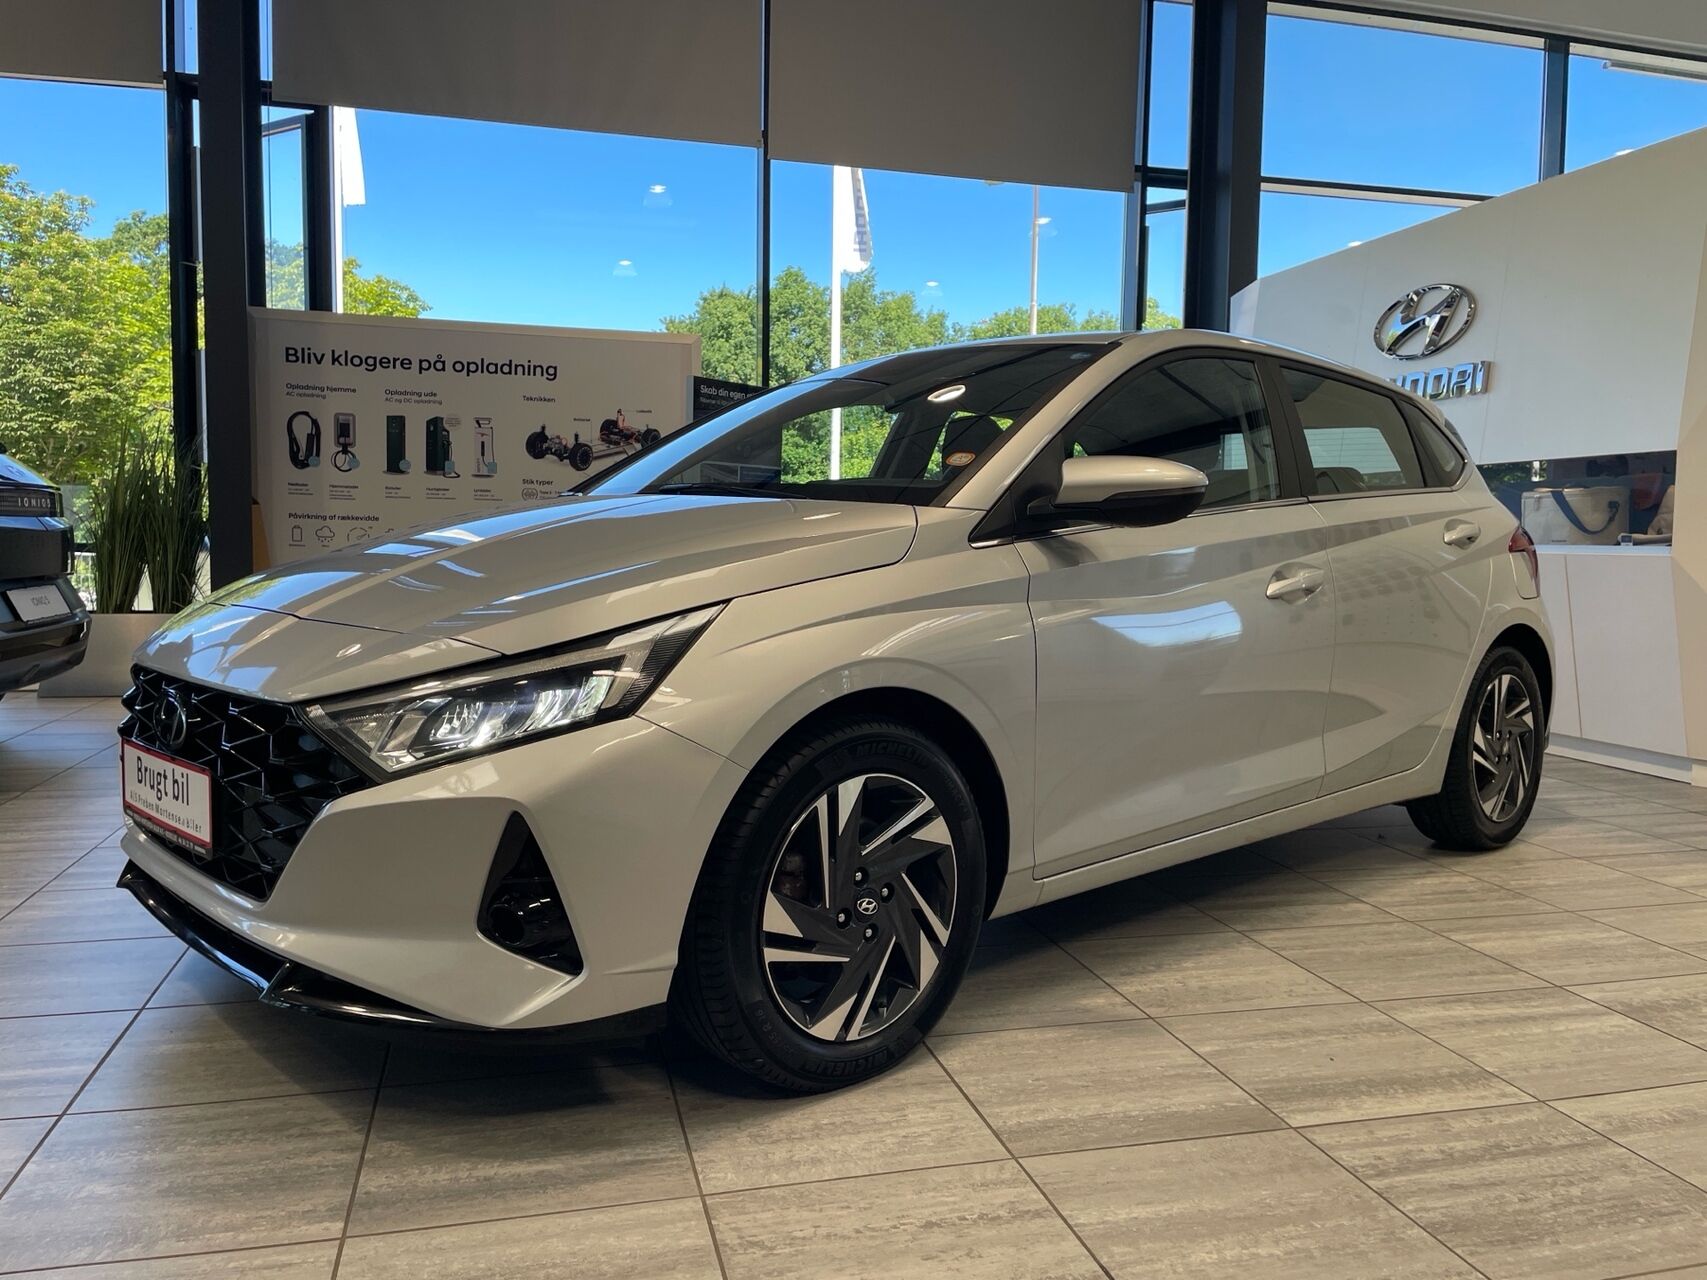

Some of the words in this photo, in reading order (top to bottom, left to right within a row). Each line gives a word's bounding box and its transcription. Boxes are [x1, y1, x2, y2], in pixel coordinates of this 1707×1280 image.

[285, 346, 326, 365] Bliv
[331, 349, 413, 372] klogere
[418, 353, 446, 375] på
[452, 357, 558, 382] opladning
[286, 383, 325, 393] Opladning
[326, 386, 357, 394] hjemme
[384, 389, 422, 398] Opladning
[718, 387, 729, 397] din
[729, 391, 746, 400] egen
[523, 395, 556, 403] Teknikken
[522, 478, 535, 486] Stik
[535, 479, 553, 488] typer
[288, 512, 327, 522] Påvirkning
[328, 513, 337, 521] af
[337, 513, 380, 522] rækkevidde
[136, 755, 168, 802] Brugt
[172, 767, 190, 806] bil
